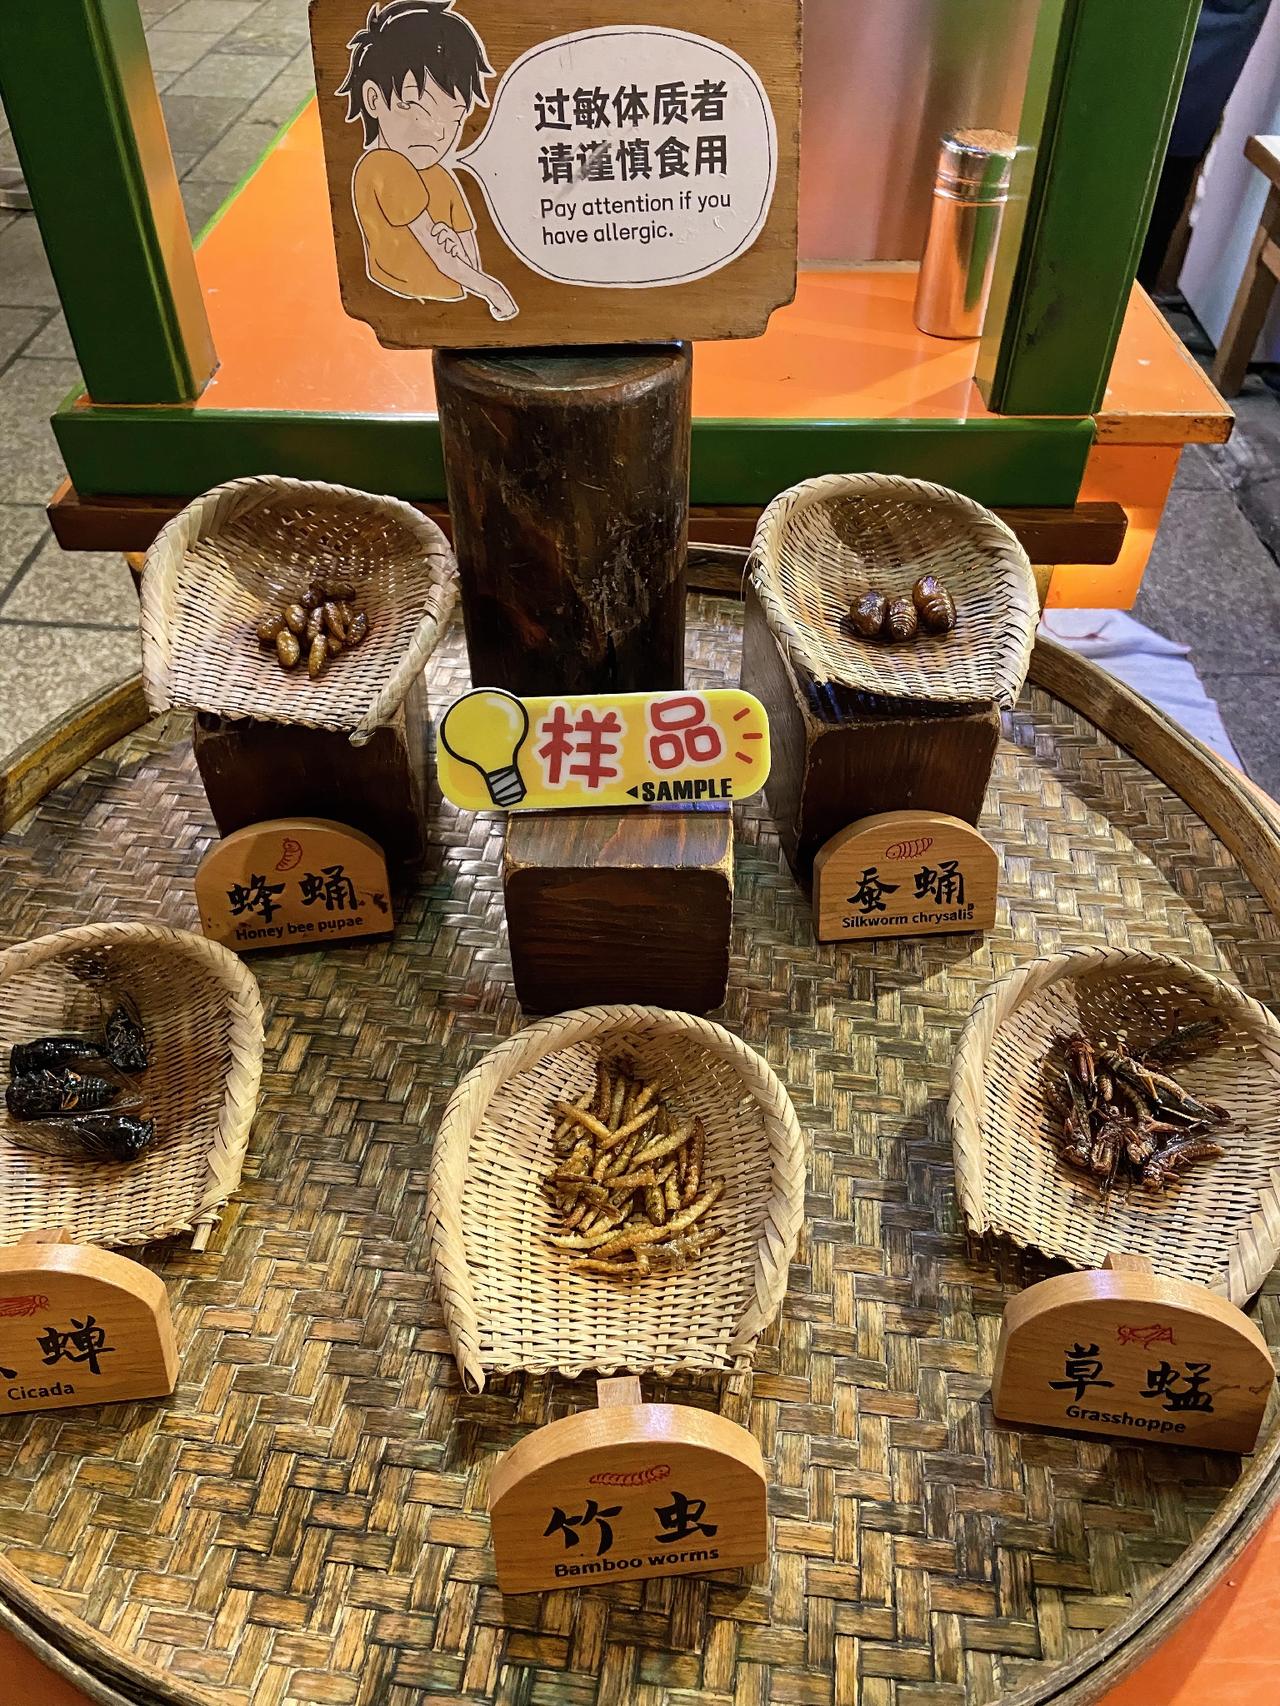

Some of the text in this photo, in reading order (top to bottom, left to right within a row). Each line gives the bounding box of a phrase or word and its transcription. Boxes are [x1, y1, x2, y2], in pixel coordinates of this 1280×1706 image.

[534, 79, 728, 131] 过敏体质者
[538, 135, 728, 184] 请谨慎食用
[540, 190, 731, 220] Pay attention if you
[542, 221, 674, 245] have allergic.
[538, 696, 722, 788] 样品
[642, 778, 733, 801] SAMPLE
[227, 865, 358, 923] 蜂蛹
[847, 860, 964, 914] 蚕蛹
[236, 916, 363, 941] Honey bee pupae
[842, 908, 974, 928] Silkworm chrysalis
[0, 1315, 116, 1379] 蝉
[7, 1382, 75, 1401] Cicada
[1048, 1342, 1215, 1413] 草蜢
[1066, 1405, 1187, 1434] Grasshoppe
[543, 1491, 718, 1556] 竹虫
[554, 1548, 719, 1578] Bamboo worms
